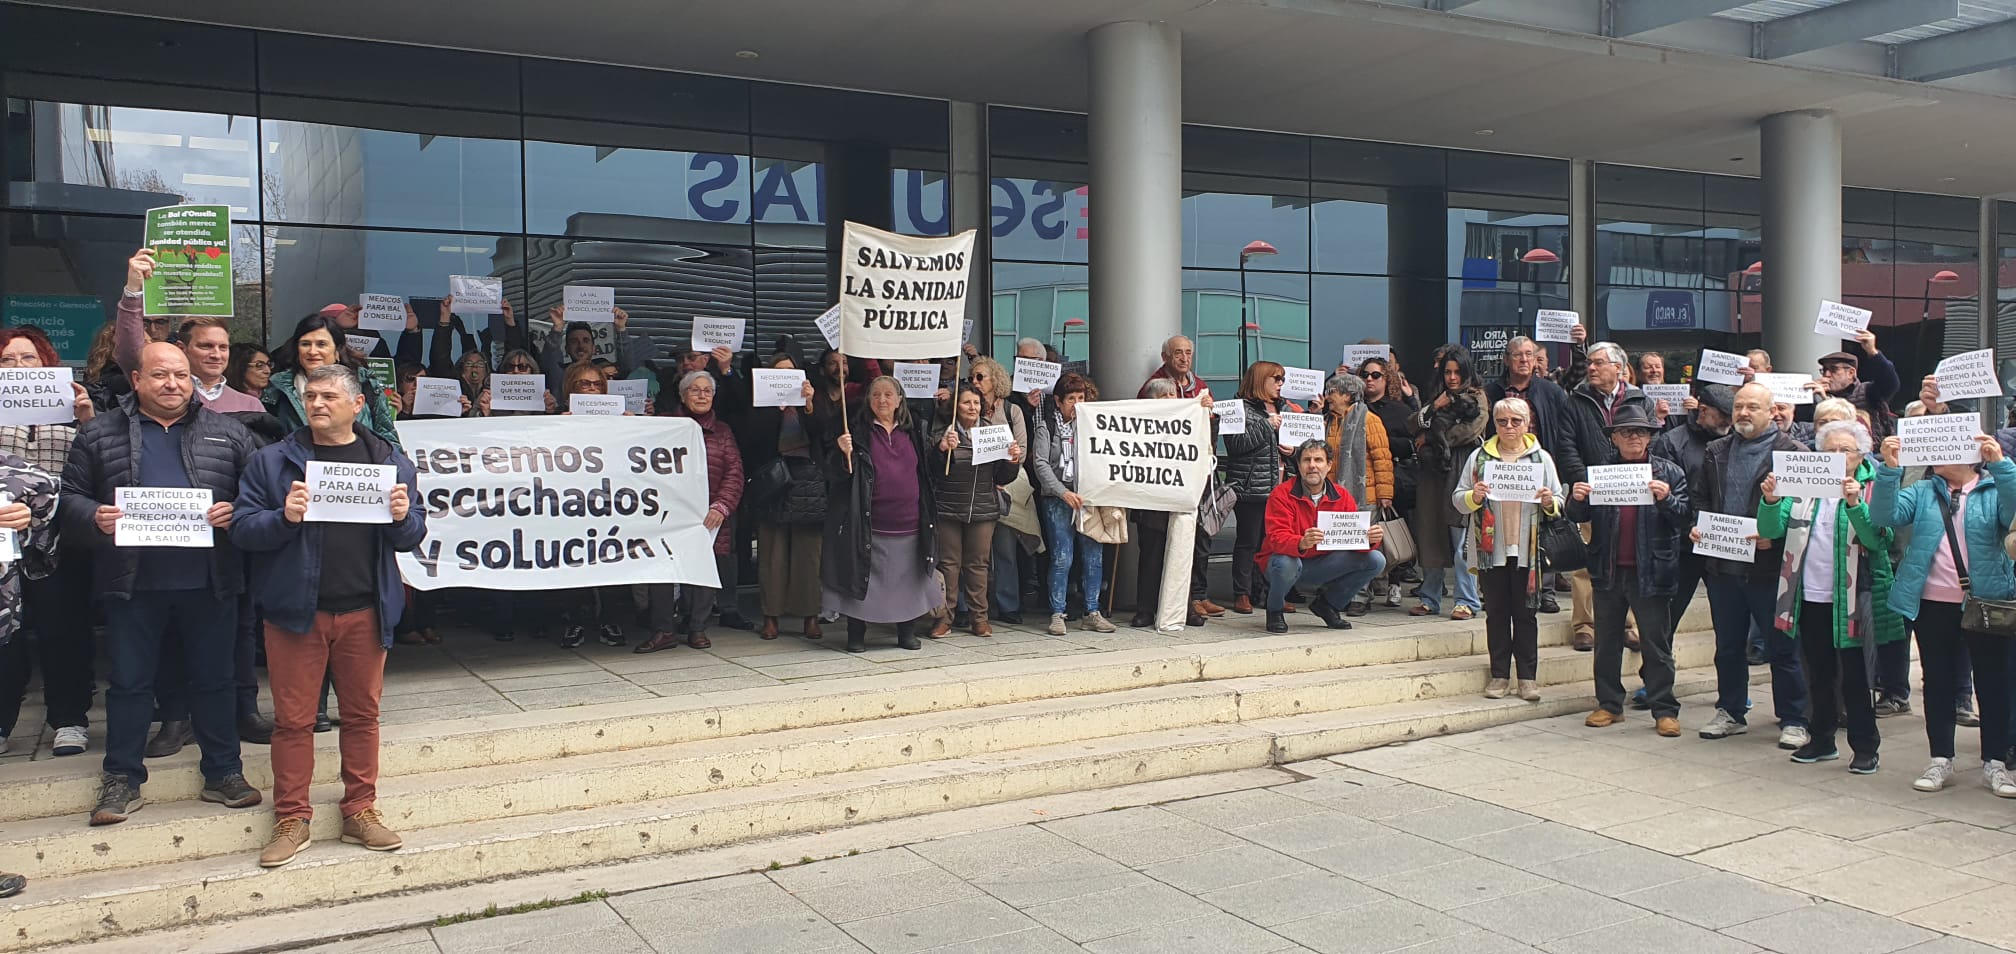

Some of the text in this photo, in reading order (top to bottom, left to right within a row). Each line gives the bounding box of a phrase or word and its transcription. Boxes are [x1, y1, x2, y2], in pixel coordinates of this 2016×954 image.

[858, 247, 964, 271] SALVEMOS
[845, 276, 964, 300] LA SANIDAD
[10, 300, 52, 308] Dirección
[1831, 304, 1862, 316] SANIDAD
[11, 315, 64, 326] Servicio
[863, 304, 948, 330] PÚBLICA
[1819, 318, 1838, 327] PARA
[1018, 360, 1058, 370] MERECEMOS
[1018, 369, 1056, 378] ASISTENCIA
[1936, 373, 1969, 382] DERECHO
[0, 386, 60, 394] ARA BAL
[1282, 414, 1322, 422] MERECEMOS
[1917, 416, 1962, 424] ARTÍCULO
[1096, 414, 1192, 435] SALVEMOS
[1284, 422, 1322, 430] ASISTENCIA
[1290, 430, 1314, 438] MÉDICA
[1090, 437, 1198, 462] LA SANIDAD
[1902, 444, 1960, 452] PROTECCIÓN
[628, 446, 687, 474] ser
[323, 464, 380, 477] MÉDICOS
[1109, 461, 1184, 486] PÚBLICA
[1787, 464, 1830, 474] PÚBLICA
[1776, 476, 1802, 484] PARA
[319, 481, 382, 492] PARA BAL
[140, 489, 193, 499] ARTÍCULO
[420, 477, 668, 524] scuchados,
[121, 522, 190, 532] PROTECCIÓN
[1712, 524, 1738, 534] SOMOS
[1698, 542, 1750, 556] DE PRIMERA
